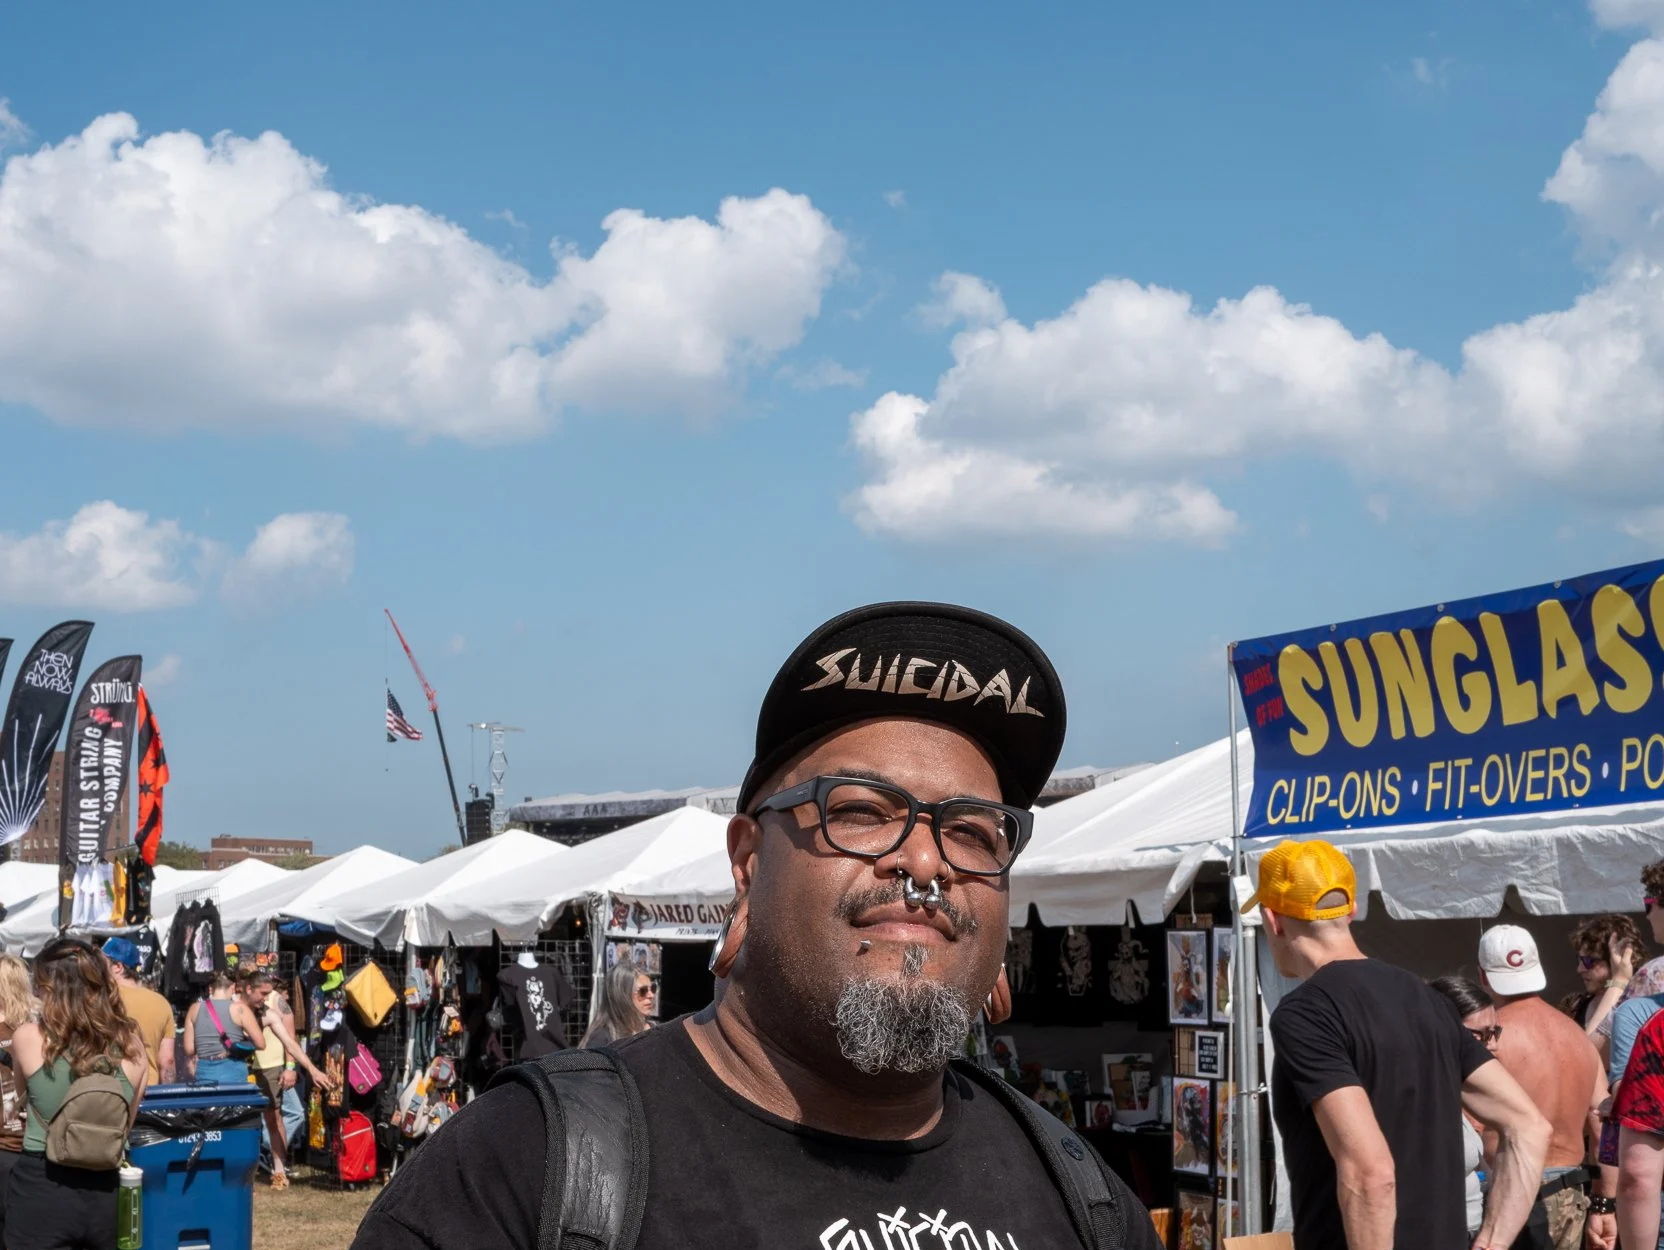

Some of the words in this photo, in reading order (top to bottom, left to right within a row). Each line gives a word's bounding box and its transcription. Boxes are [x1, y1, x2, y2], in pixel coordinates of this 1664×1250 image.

[34, 660, 73, 680] NOW
[40, 648, 74, 668] THEN
[1277, 573, 1664, 756] SUNGLAS
[24, 671, 73, 695] ALWAYS
[800, 647, 1045, 719] SUICIDAL
[80, 726, 102, 791] STRING
[1267, 767, 1401, 825] CLIP-ONS
[1426, 743, 1592, 811] FIT-OVERS
[78, 797, 101, 863] GUITAR
[650, 903, 695, 927] JARED
[1506, 949, 1524, 967] C
